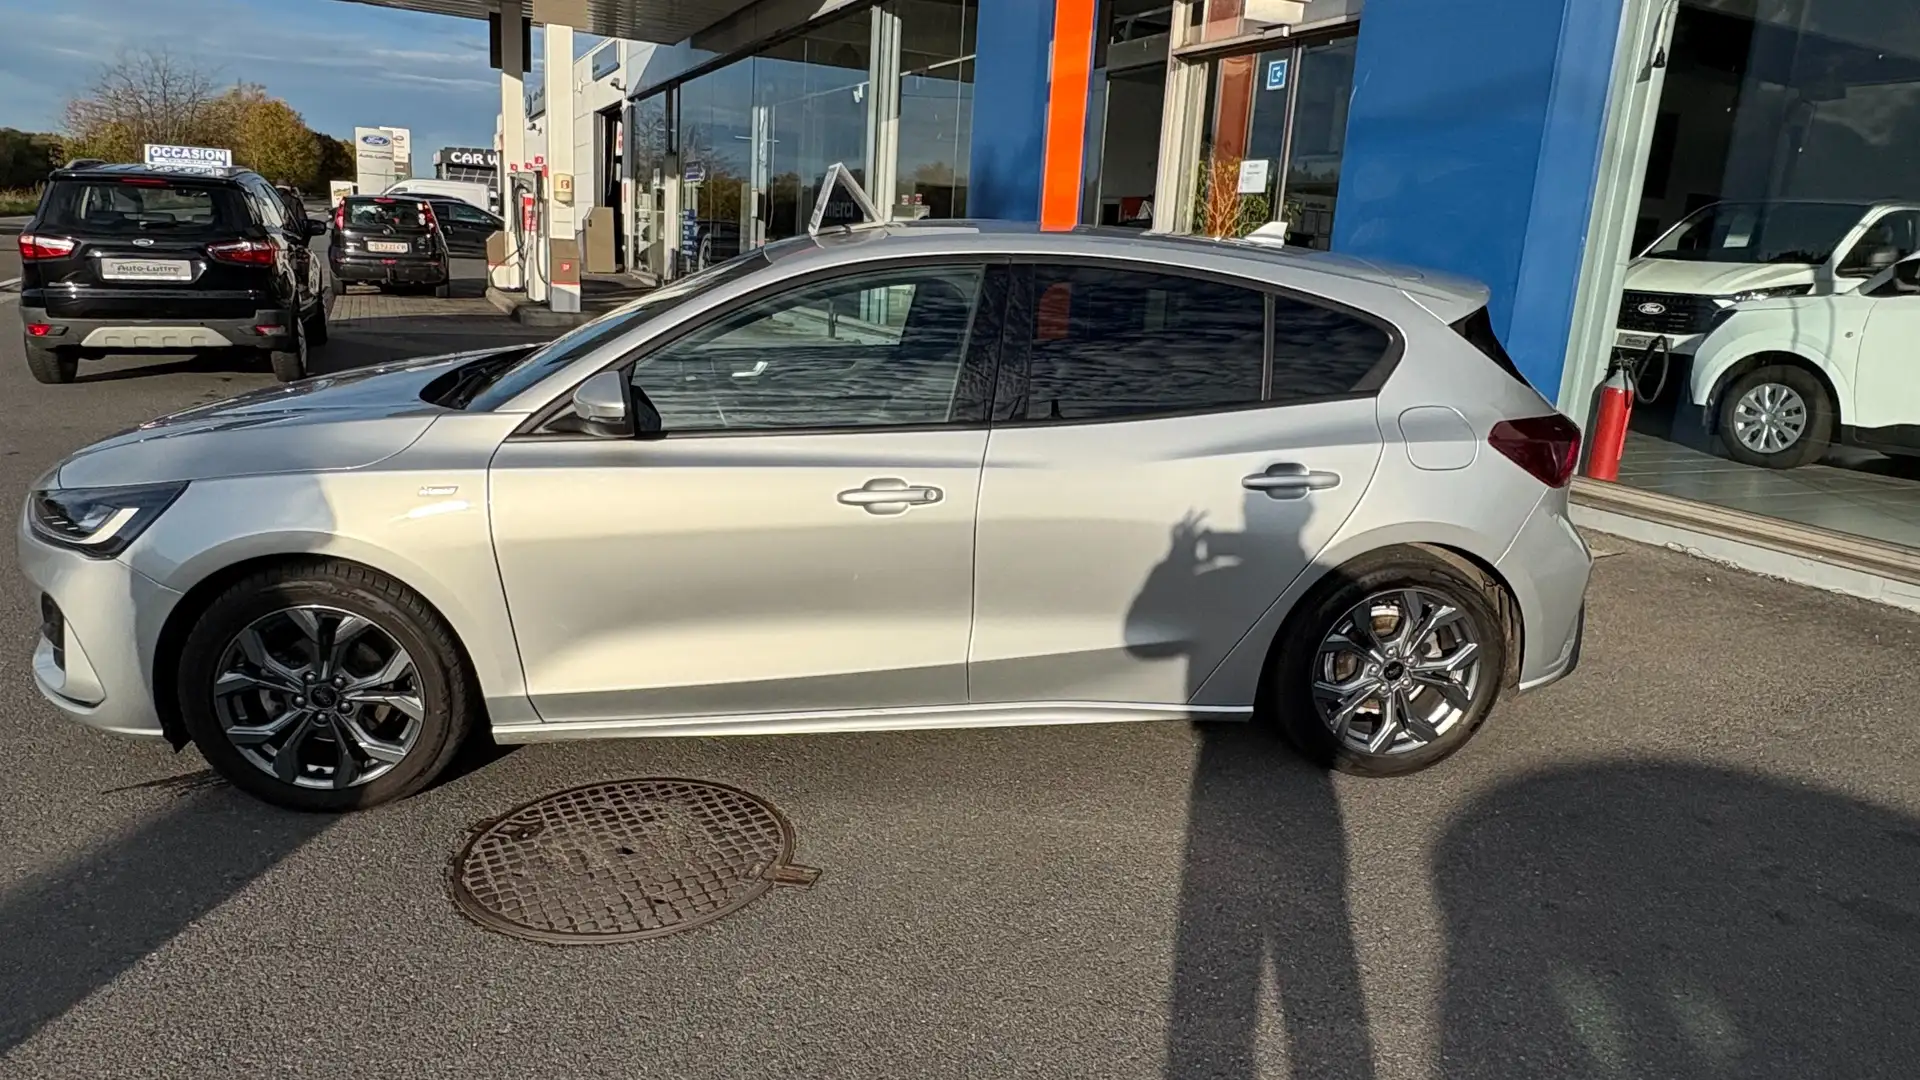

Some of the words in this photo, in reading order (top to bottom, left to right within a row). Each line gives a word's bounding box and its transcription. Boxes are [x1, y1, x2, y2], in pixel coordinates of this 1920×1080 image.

[150, 146, 225, 161] OCCASION
[450, 152, 484, 165] CAR
[117, 264, 180, 272] Auto-Luttre
